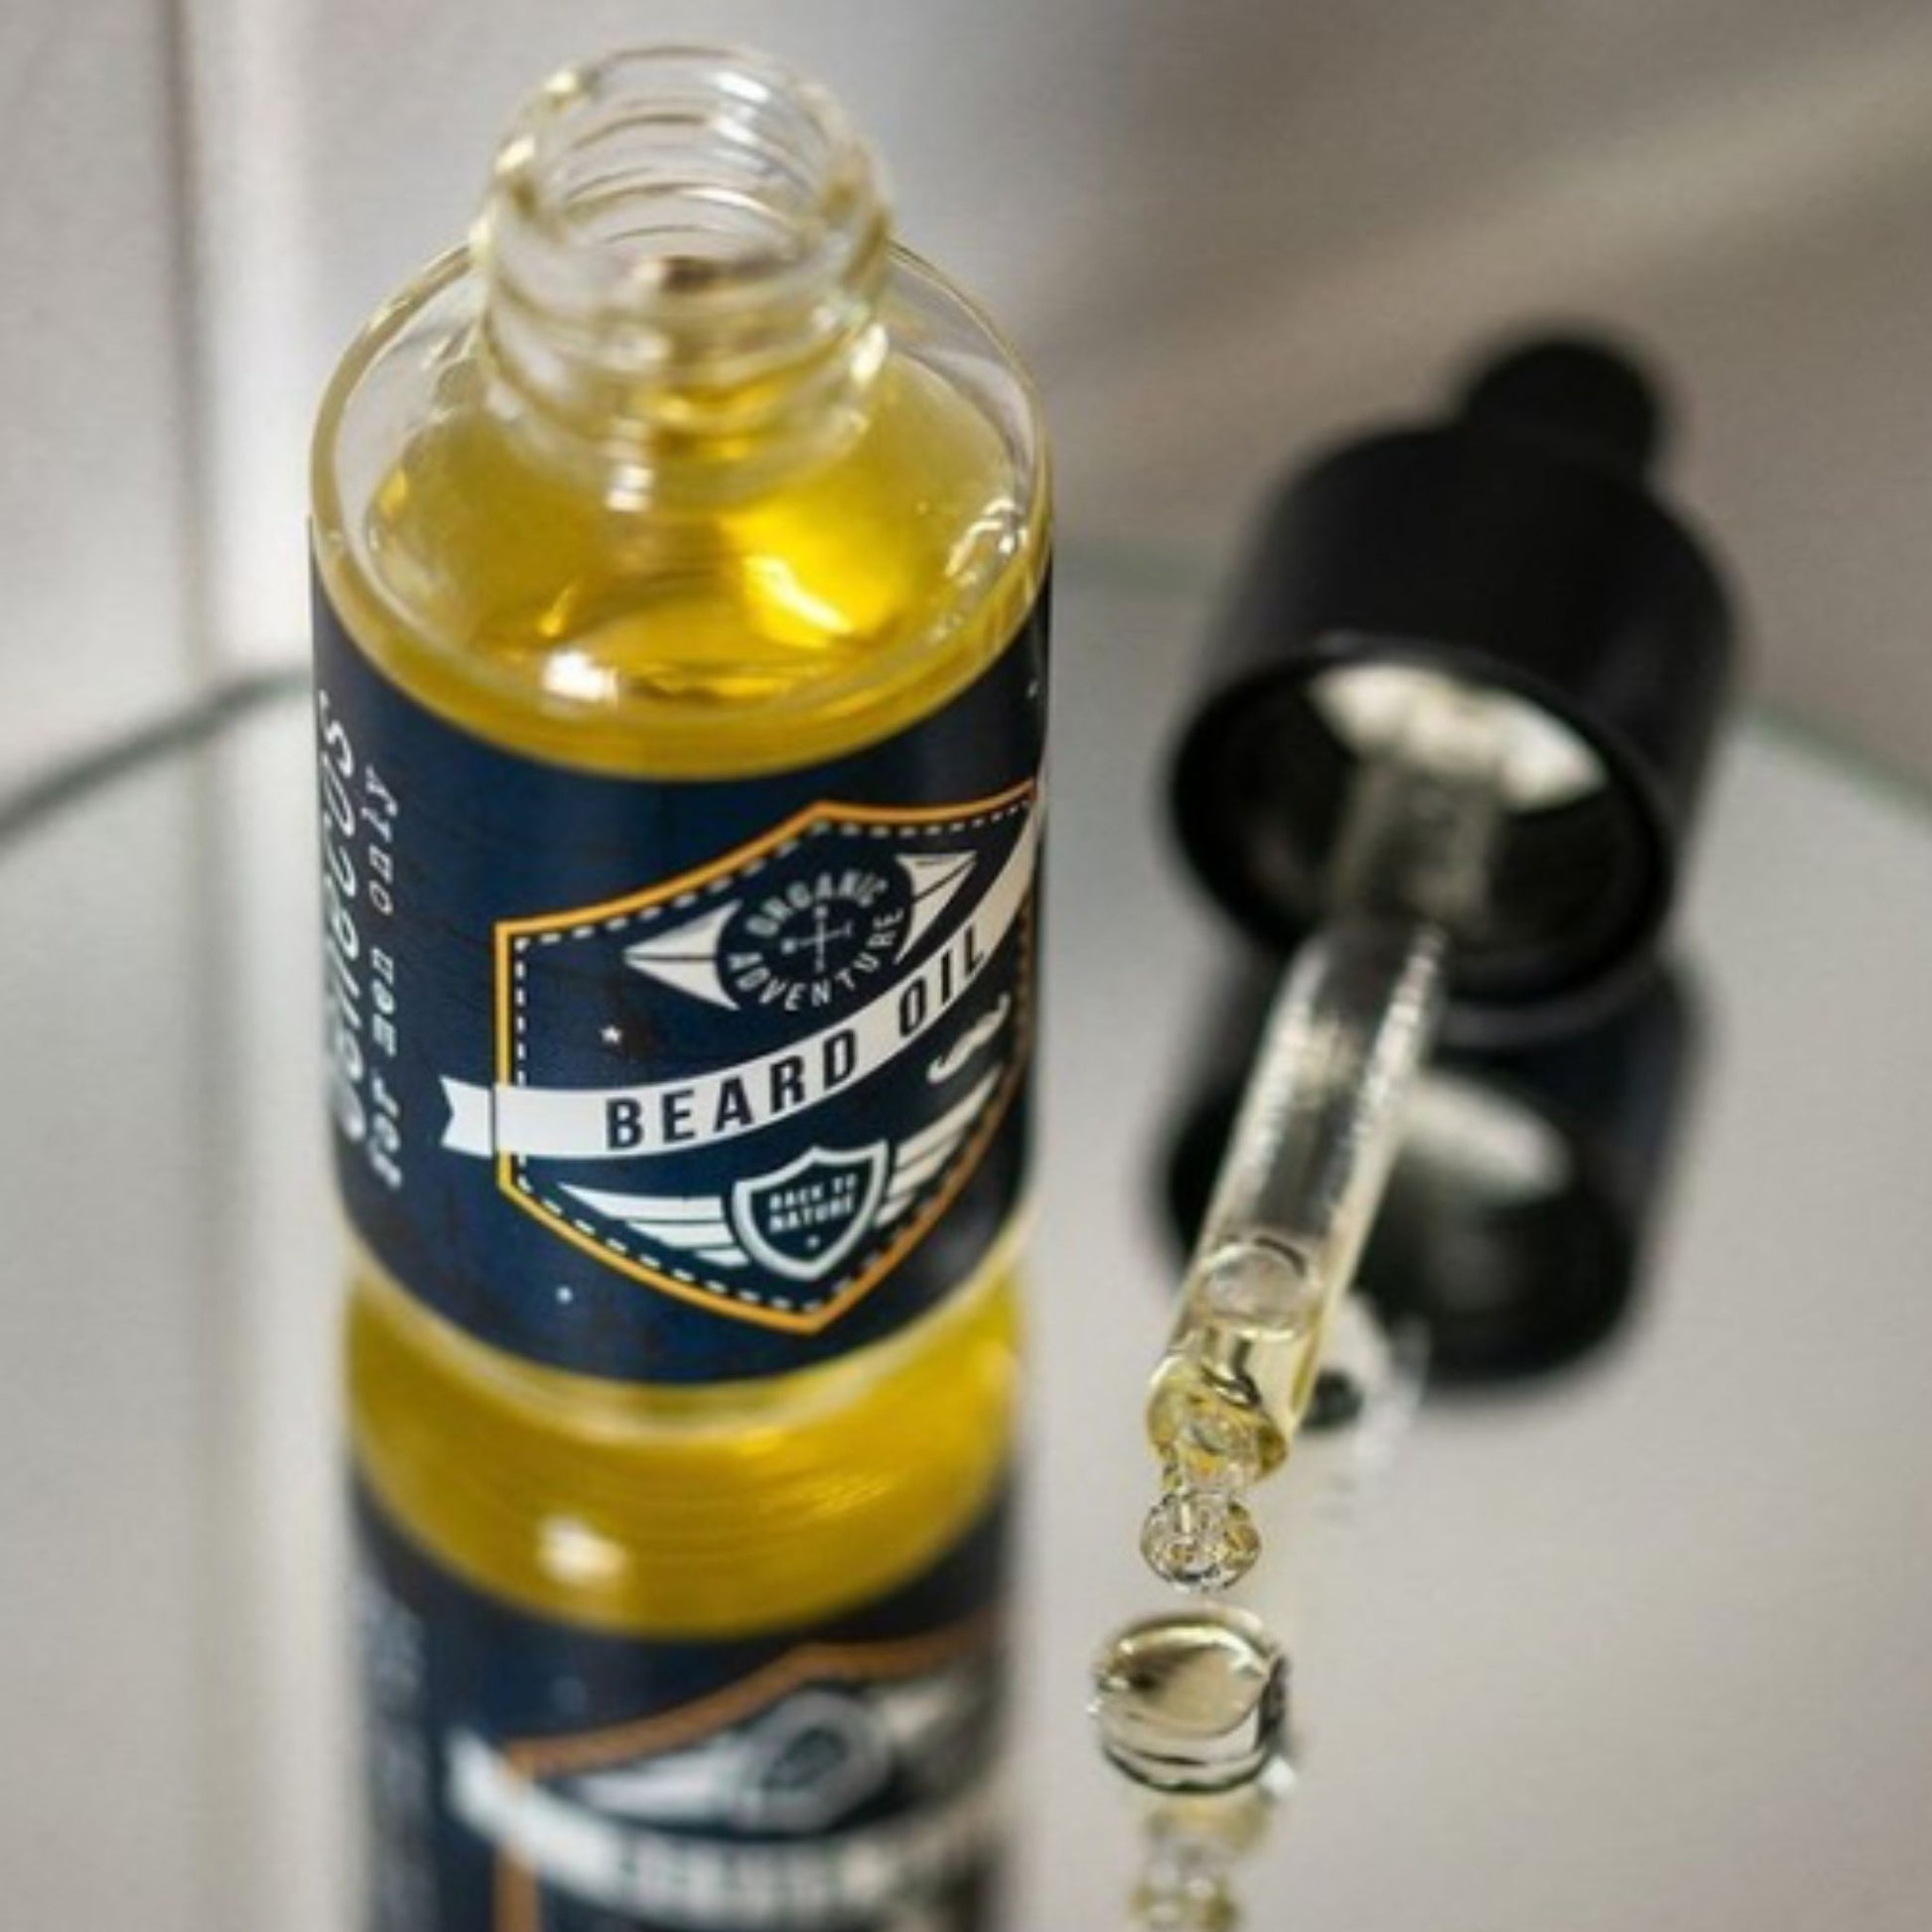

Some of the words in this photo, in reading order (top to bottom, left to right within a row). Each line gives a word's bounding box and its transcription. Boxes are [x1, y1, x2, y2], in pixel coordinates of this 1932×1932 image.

[360, 763, 399, 915] only
[728, 907, 903, 1011] ADVENTURE
[605, 1028, 858, 1152] BEARD
[898, 924, 986, 1038] OIL
